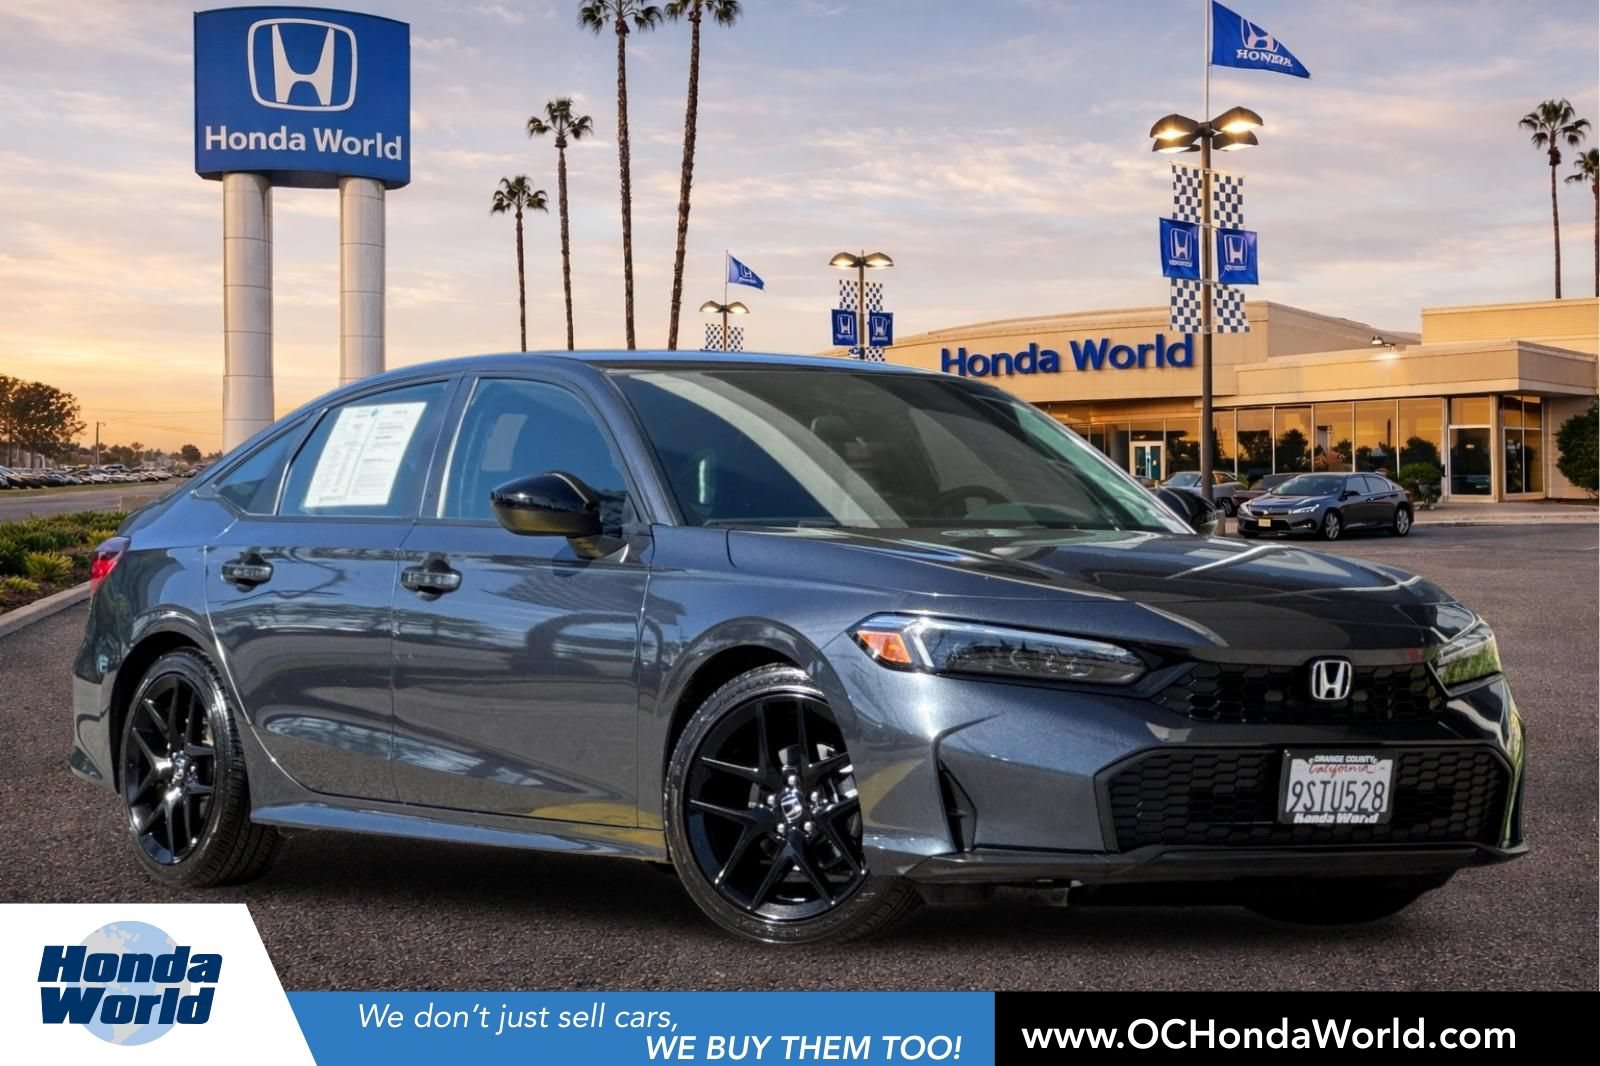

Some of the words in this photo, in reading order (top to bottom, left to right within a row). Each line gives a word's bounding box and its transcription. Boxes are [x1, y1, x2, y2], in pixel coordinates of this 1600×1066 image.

[1236, 49, 1293, 67] HONDA
[205, 125, 306, 151] Honda
[313, 127, 402, 160] World
[941, 342, 1060, 377] Honda
[1070, 333, 1195, 370] World
[1314, 755, 1344, 763] ORANGE
[1345, 755, 1374, 763] COUNTY
[1309, 764, 1374, 778] California
[1289, 780, 1385, 813] 9STU528
[1294, 813, 1335, 823] Honda
[1336, 813, 1379, 823] World
